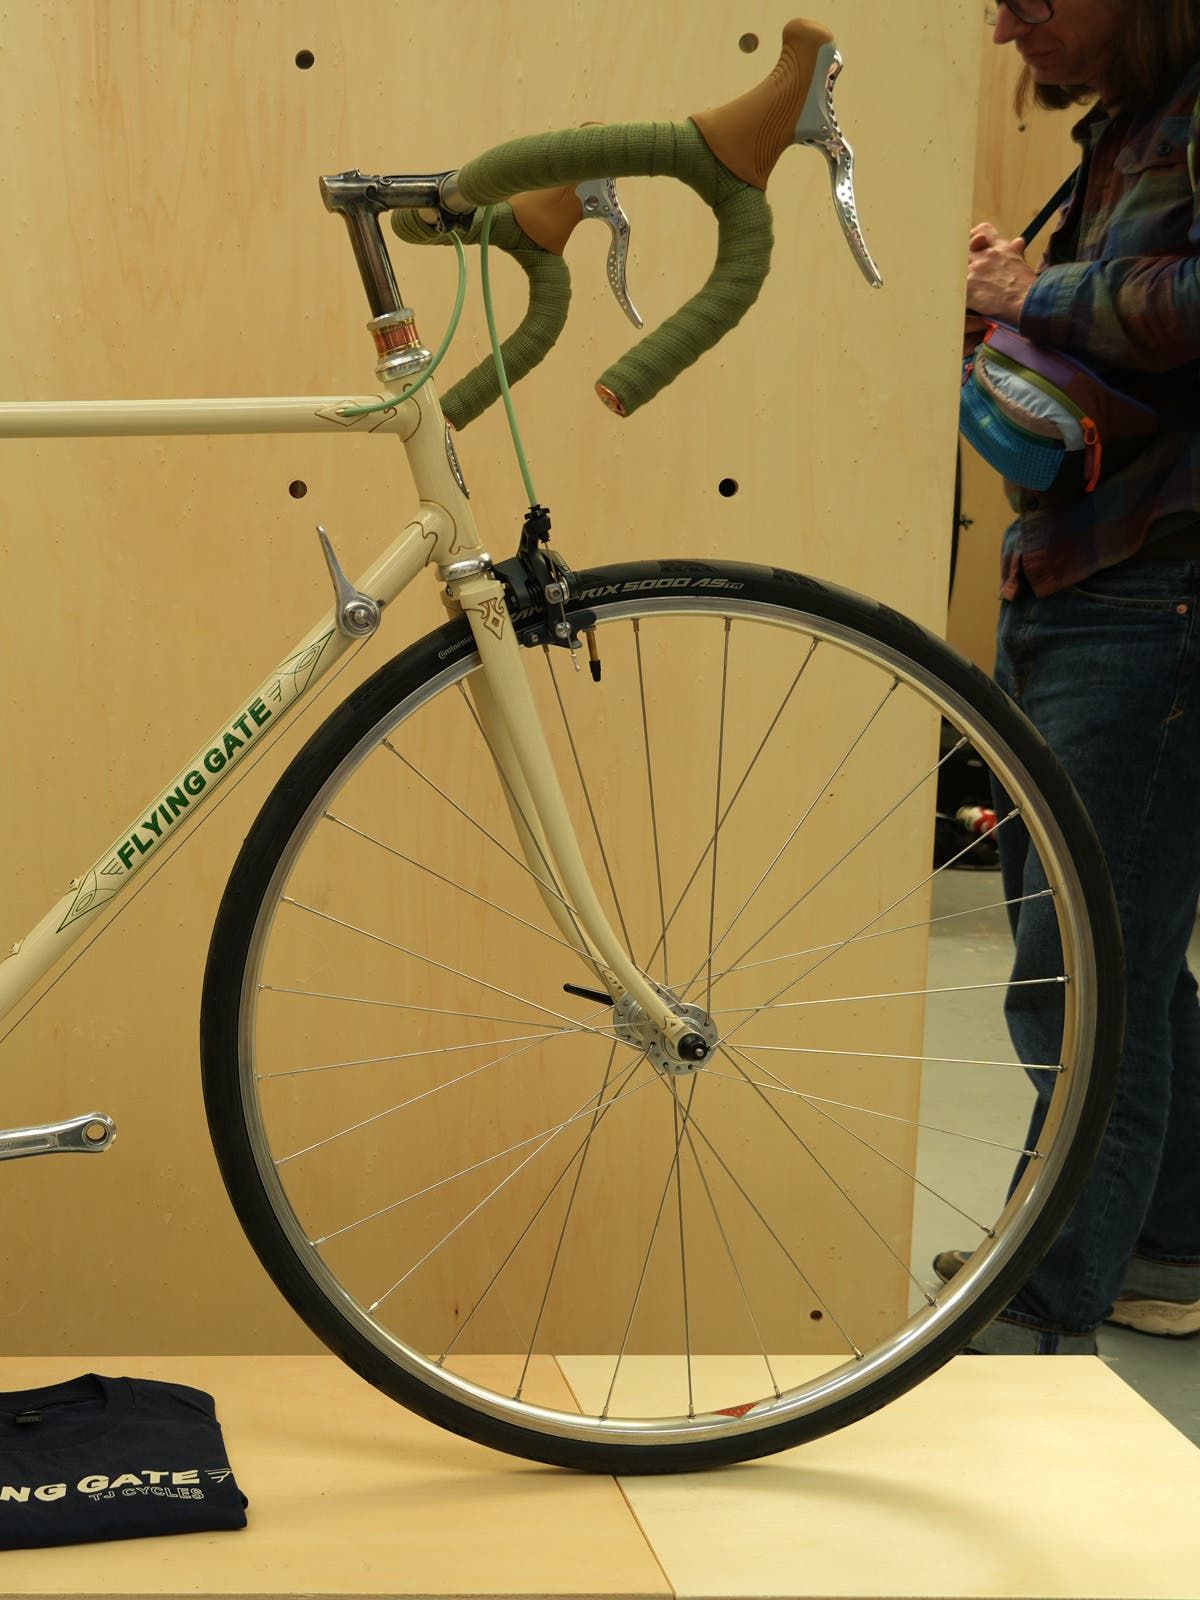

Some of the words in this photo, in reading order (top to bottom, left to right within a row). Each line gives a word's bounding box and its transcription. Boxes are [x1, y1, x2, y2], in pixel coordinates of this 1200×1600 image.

[572, 582, 621, 600] RIX
[622, 577, 692, 592] 5000
[692, 578, 729, 588] AS
[437, 634, 473, 660] Continental
[116, 769, 207, 870] FLYING
[203, 696, 273, 774] GATE
[76, 1469, 200, 1494] GATE
[88, 1490, 116, 1501] TJ
[121, 1485, 205, 1500] CYCLES
